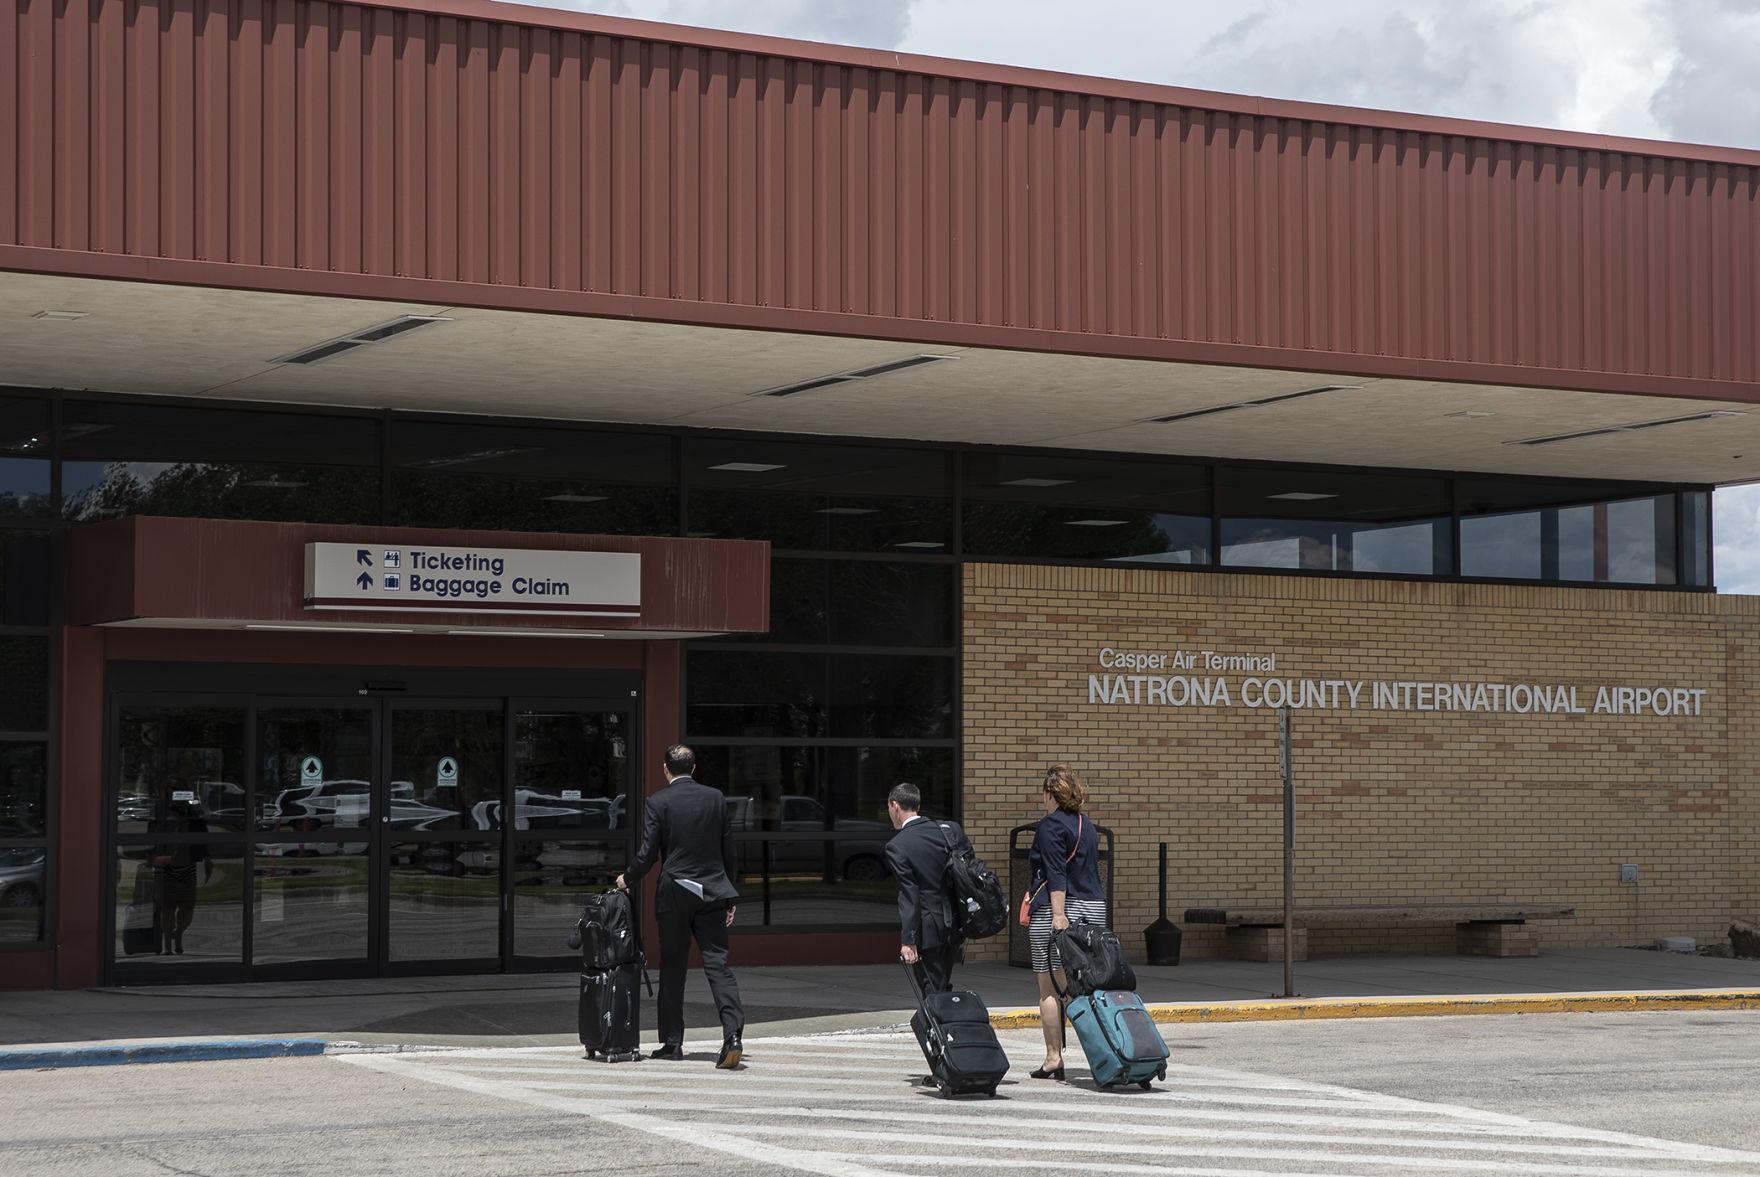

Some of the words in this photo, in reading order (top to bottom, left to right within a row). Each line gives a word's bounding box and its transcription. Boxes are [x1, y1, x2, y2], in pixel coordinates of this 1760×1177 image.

[410, 552, 505, 577] Ticketing
[410, 575, 502, 598] Baggage
[512, 577, 570, 597] Claim
[1098, 647, 1168, 672] Casper
[1172, 650, 1197, 670] Air
[1201, 651, 1276, 672] Terminal
[1088, 674, 1231, 706] NATRONA
[1242, 678, 1364, 709] COUNTY
[1372, 681, 1586, 713] INTERNATIONAL
[1593, 686, 1707, 716] AIRPORT
